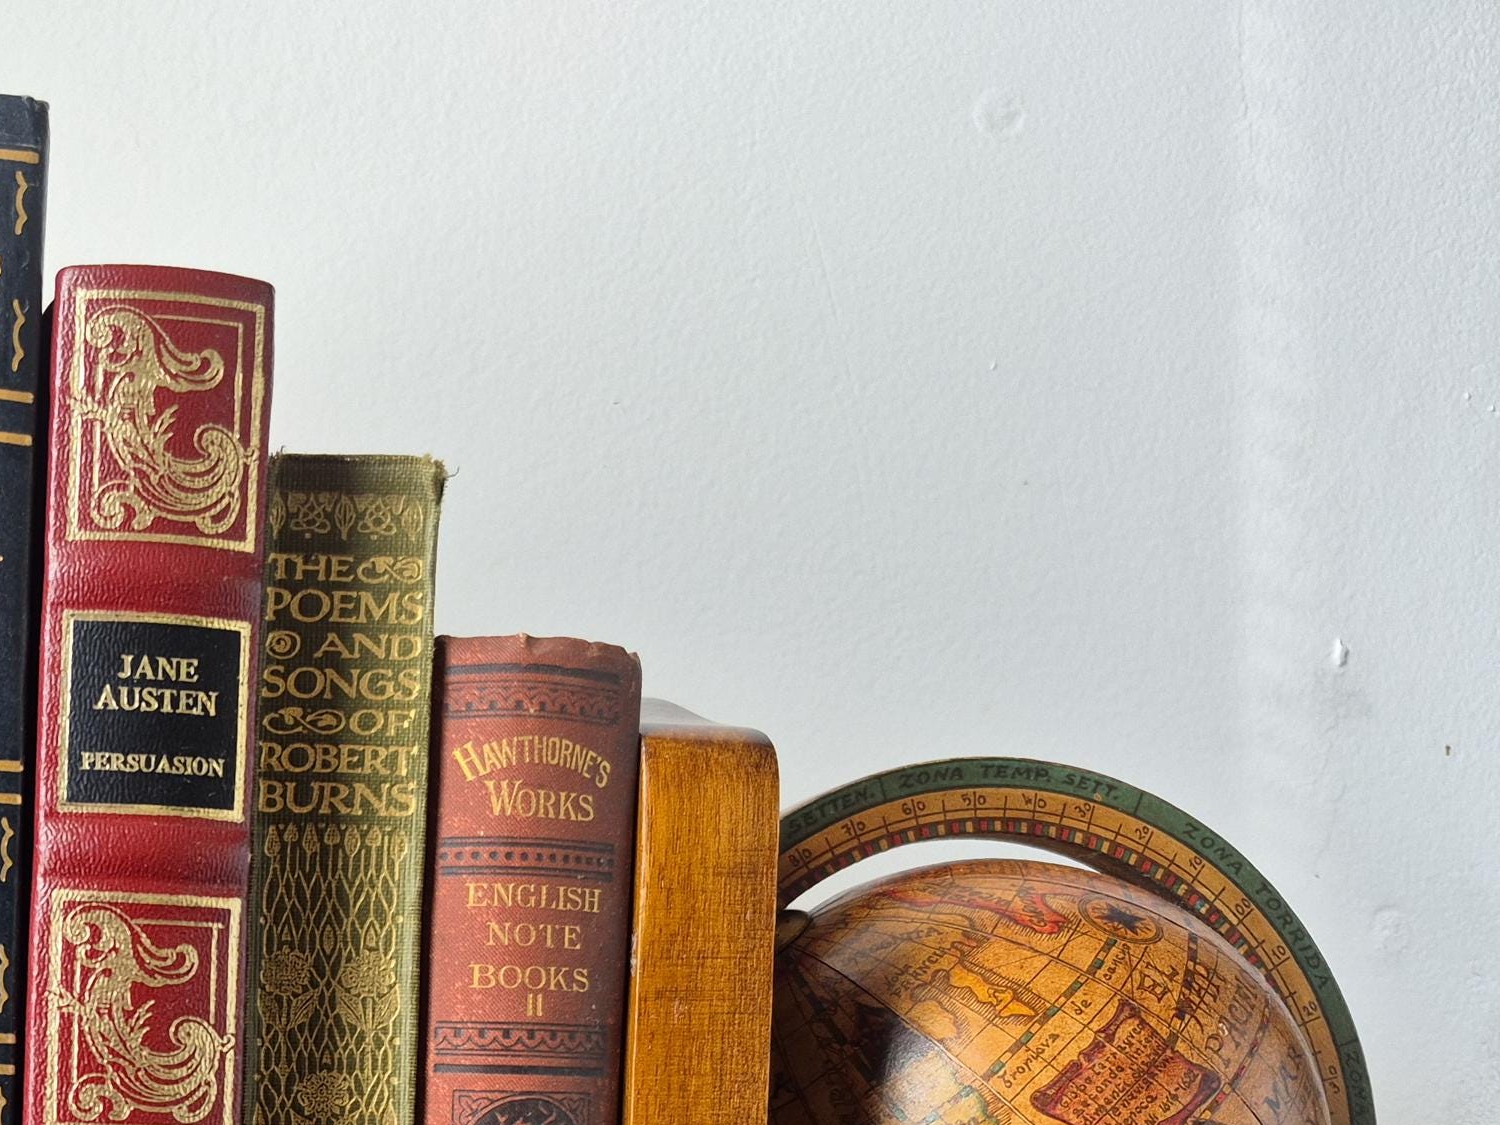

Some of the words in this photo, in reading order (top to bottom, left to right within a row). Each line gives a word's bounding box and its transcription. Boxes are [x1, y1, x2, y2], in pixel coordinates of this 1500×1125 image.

[267, 552, 356, 582] THE
[265, 587, 423, 625] POEMS
[313, 632, 422, 660] AND
[117, 654, 200, 683] JANE
[262, 665, 421, 701] SONGS
[92, 684, 220, 717] AUSTEN
[349, 709, 416, 737] OF
[79, 751, 226, 778] PERSUASION
[258, 741, 419, 778] ROBERT
[898, 766, 964, 789] ZONA
[258, 780, 417, 817] BURNS
[901, 801, 927, 816] 60
[960, 792, 987, 808] 50
[1074, 802, 1092, 819] 30
[1134, 825, 1150, 841] 20
[1188, 854, 1203, 871] 10
[465, 882, 602, 913] ENGLISH
[1182, 822, 1244, 875] ZONA
[1254, 881, 1331, 991] TORRIDA
[485, 921, 582, 950] NOTE
[1272, 944, 1287, 960] 10
[467, 962, 590, 992] BOOKS
[1069, 997, 1093, 1016] de
[1302, 1002, 1318, 1018] 20
